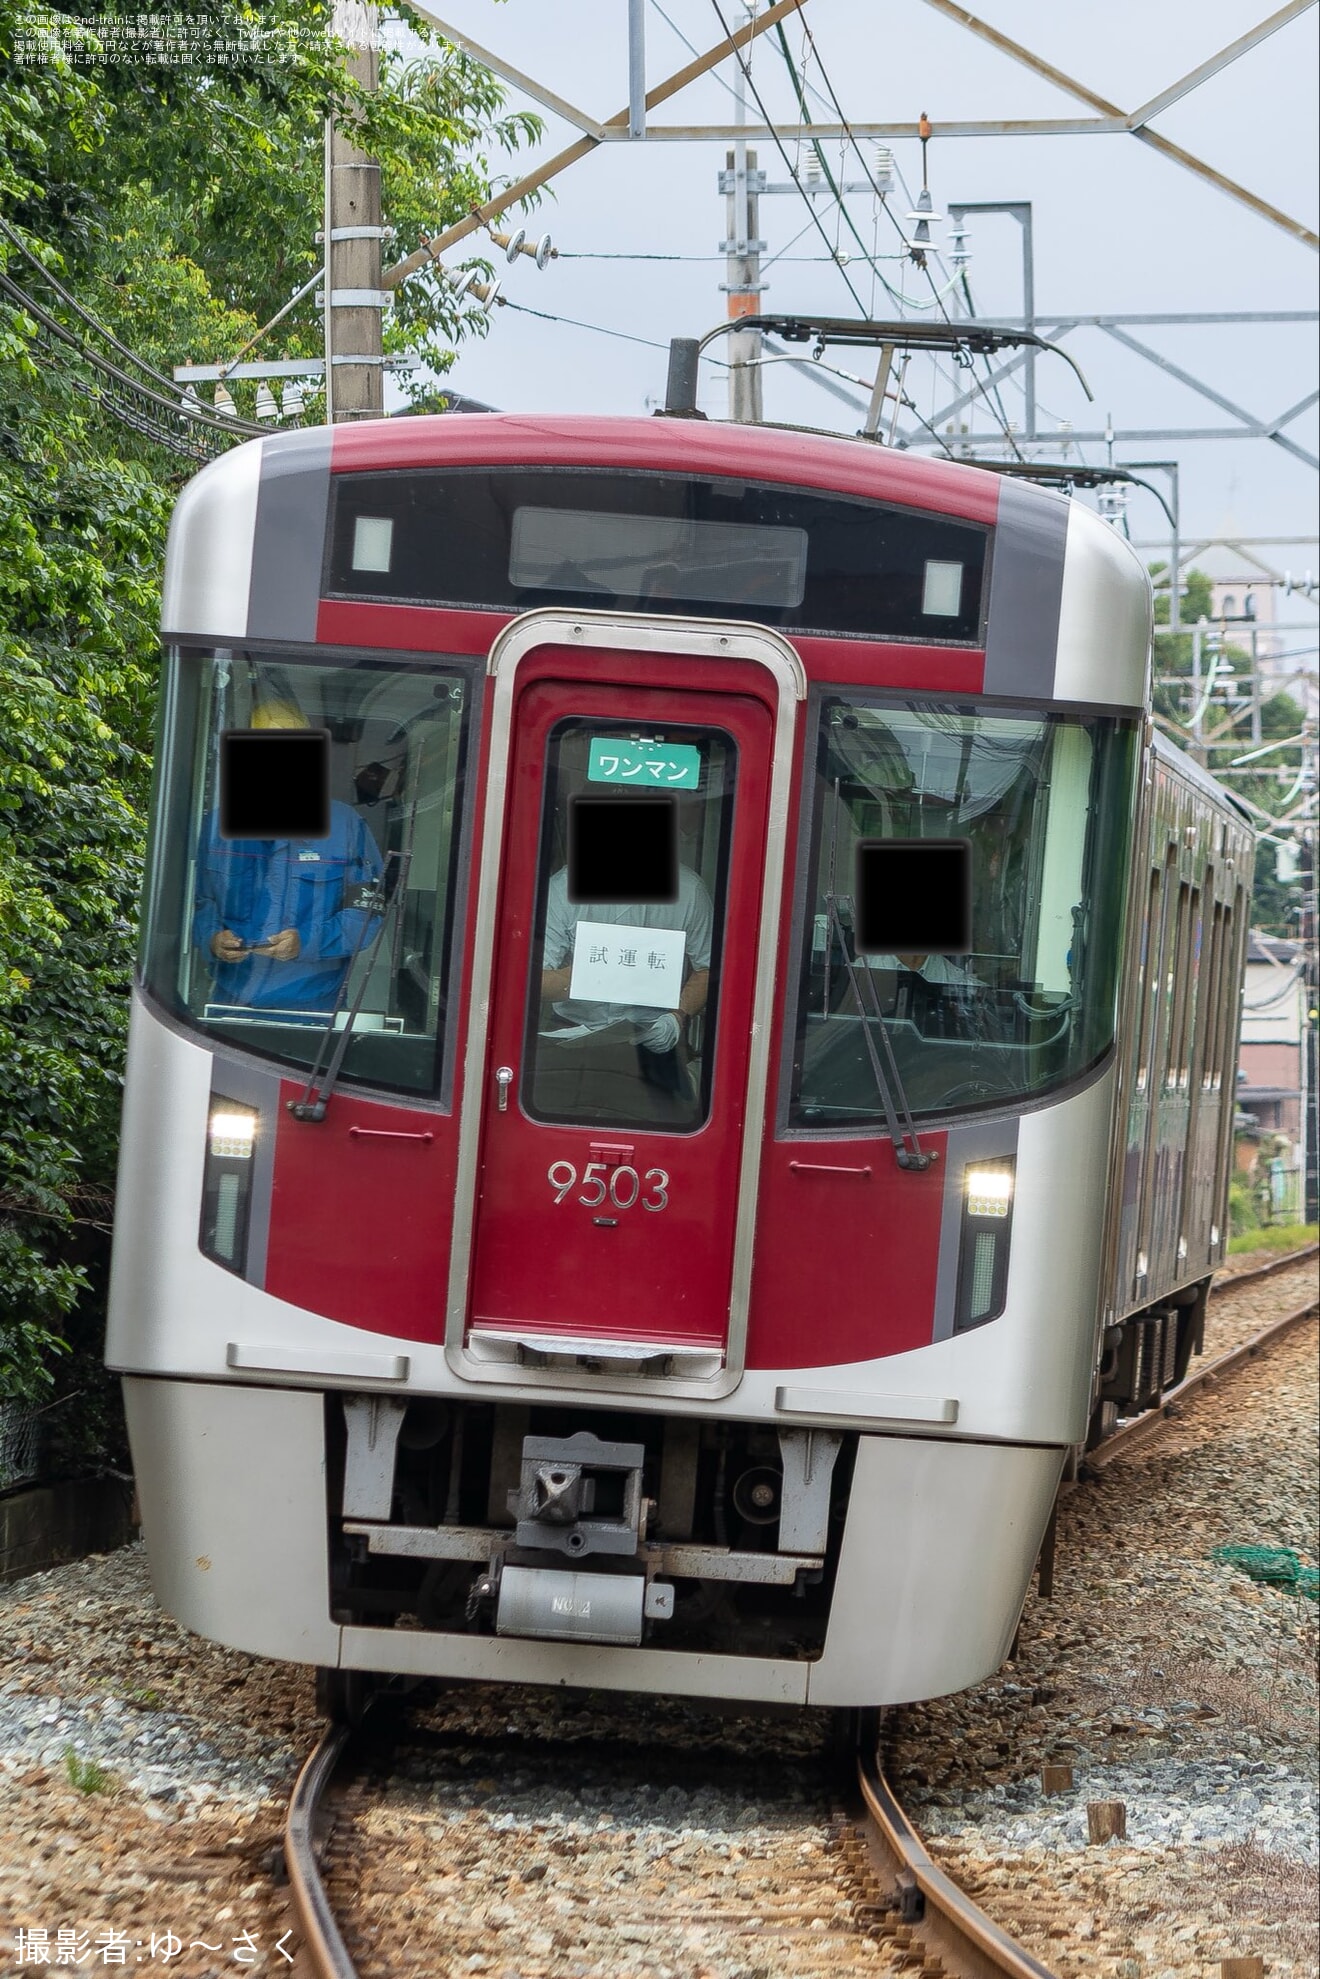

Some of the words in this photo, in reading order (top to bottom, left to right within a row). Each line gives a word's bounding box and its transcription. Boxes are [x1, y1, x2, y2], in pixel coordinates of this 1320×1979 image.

[599, 756, 689, 781] ワンマン
[588, 945, 667, 970] 試運転
[547, 1160, 670, 1212] 9503
